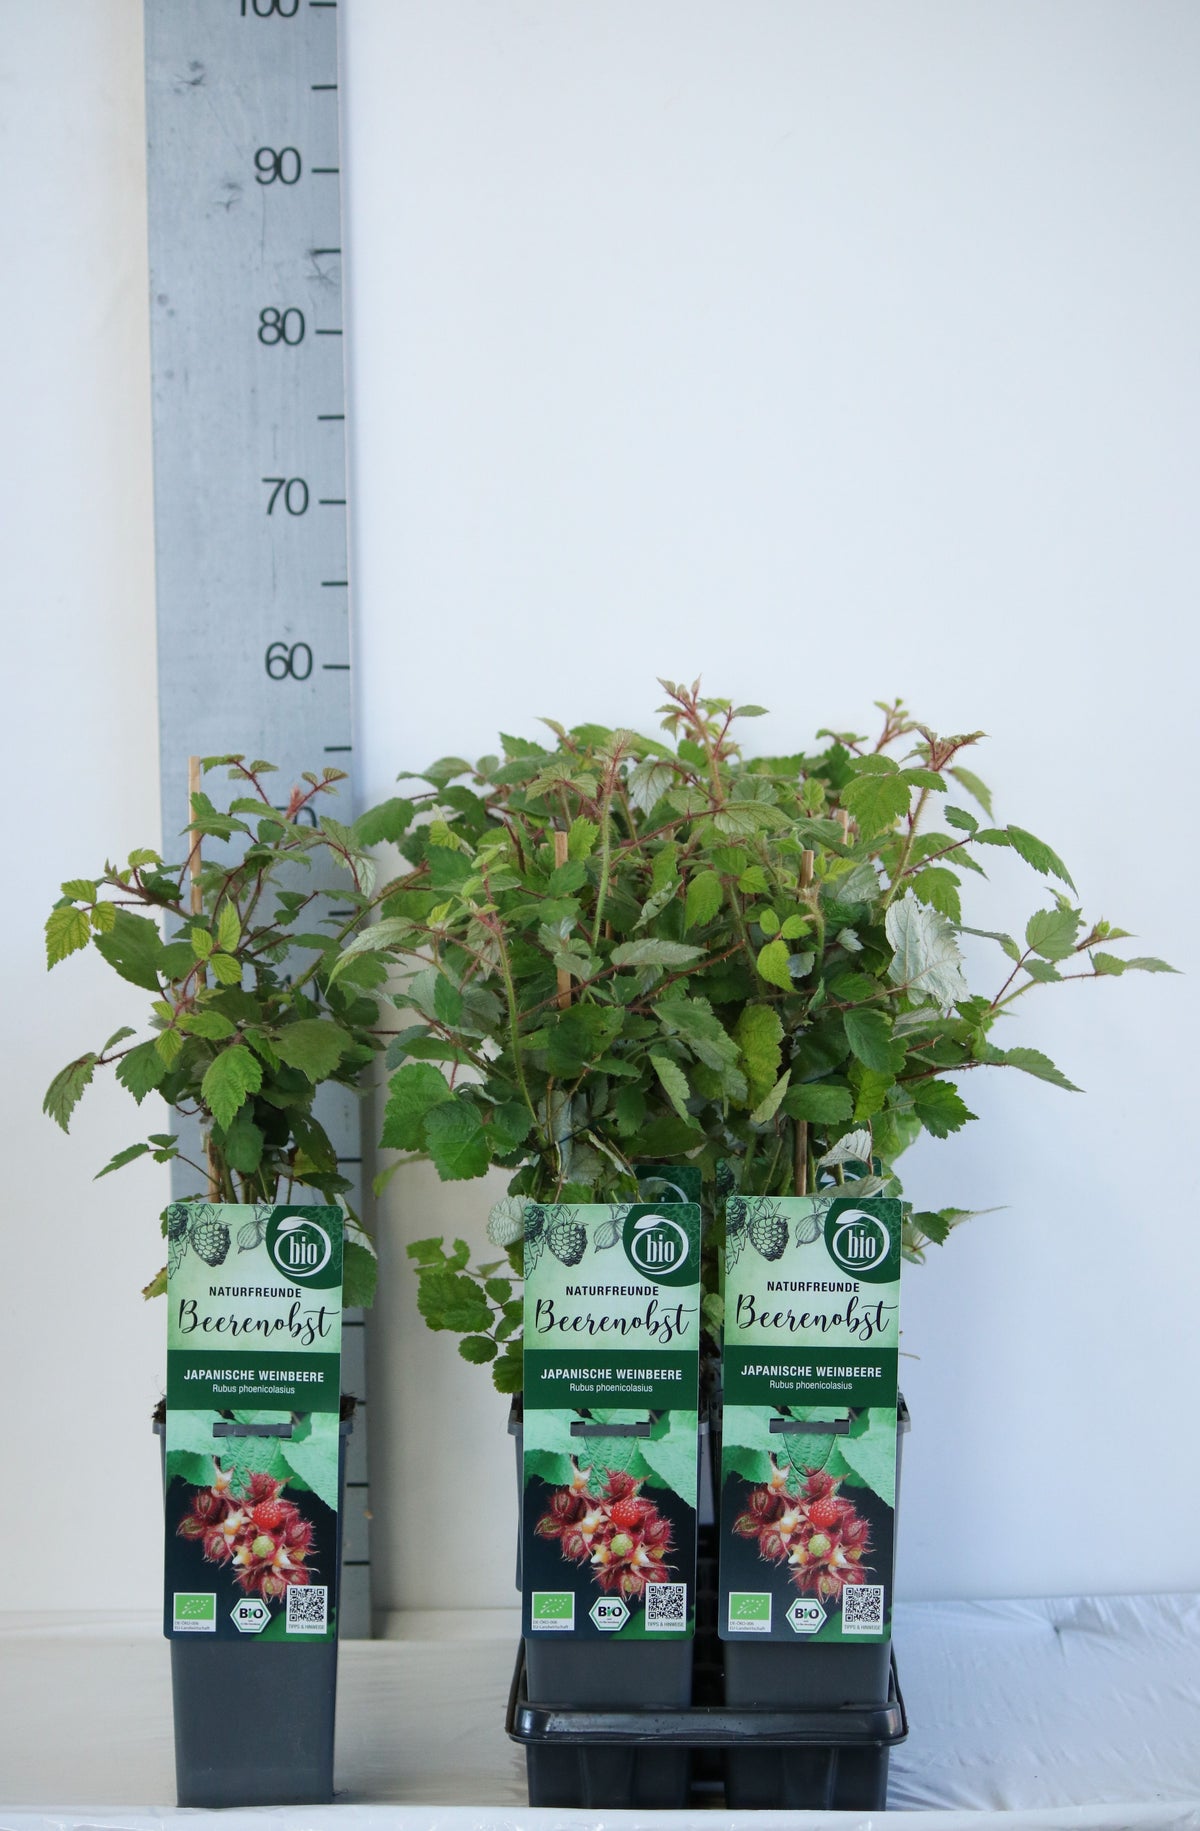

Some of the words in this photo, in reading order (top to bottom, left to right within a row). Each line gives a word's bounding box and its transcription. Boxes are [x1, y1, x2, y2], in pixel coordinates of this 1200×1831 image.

[254, 147, 301, 185] 90
[257, 307, 305, 346] 80
[262, 478, 309, 516] 70
[265, 641, 313, 681] 60
[289, 1236, 317, 1264] bio
[646, 1234, 675, 1263] bio
[847, 1229, 876, 1258] bio
[209, 1286, 302, 1298] NATURFREUNDE
[565, 1286, 659, 1296] NATURFREUNDE
[767, 1281, 860, 1292] NATURFREUNDE
[179, 1298, 340, 1346] Beerenobst
[535, 1299, 698, 1344] Beerenobst
[736, 1294, 898, 1341] Beerenobst
[184, 1370, 255, 1381] JAPANISCHE
[259, 1371, 324, 1382] WEINBEERE
[541, 1368, 612, 1379] JAPANISCHE
[616, 1369, 682, 1380] WEINBEERE
[741, 1365, 812, 1376] JAPANISCHE
[816, 1366, 882, 1378] WEINBEERE
[769, 1380, 794, 1389] Rubus
[796, 1380, 853, 1390] phoenicolasius
[212, 1384, 237, 1393] Rubus
[239, 1385, 295, 1394] phoenicolasius
[569, 1383, 594, 1392] Rubus
[596, 1383, 653, 1393] phoenicolasius
